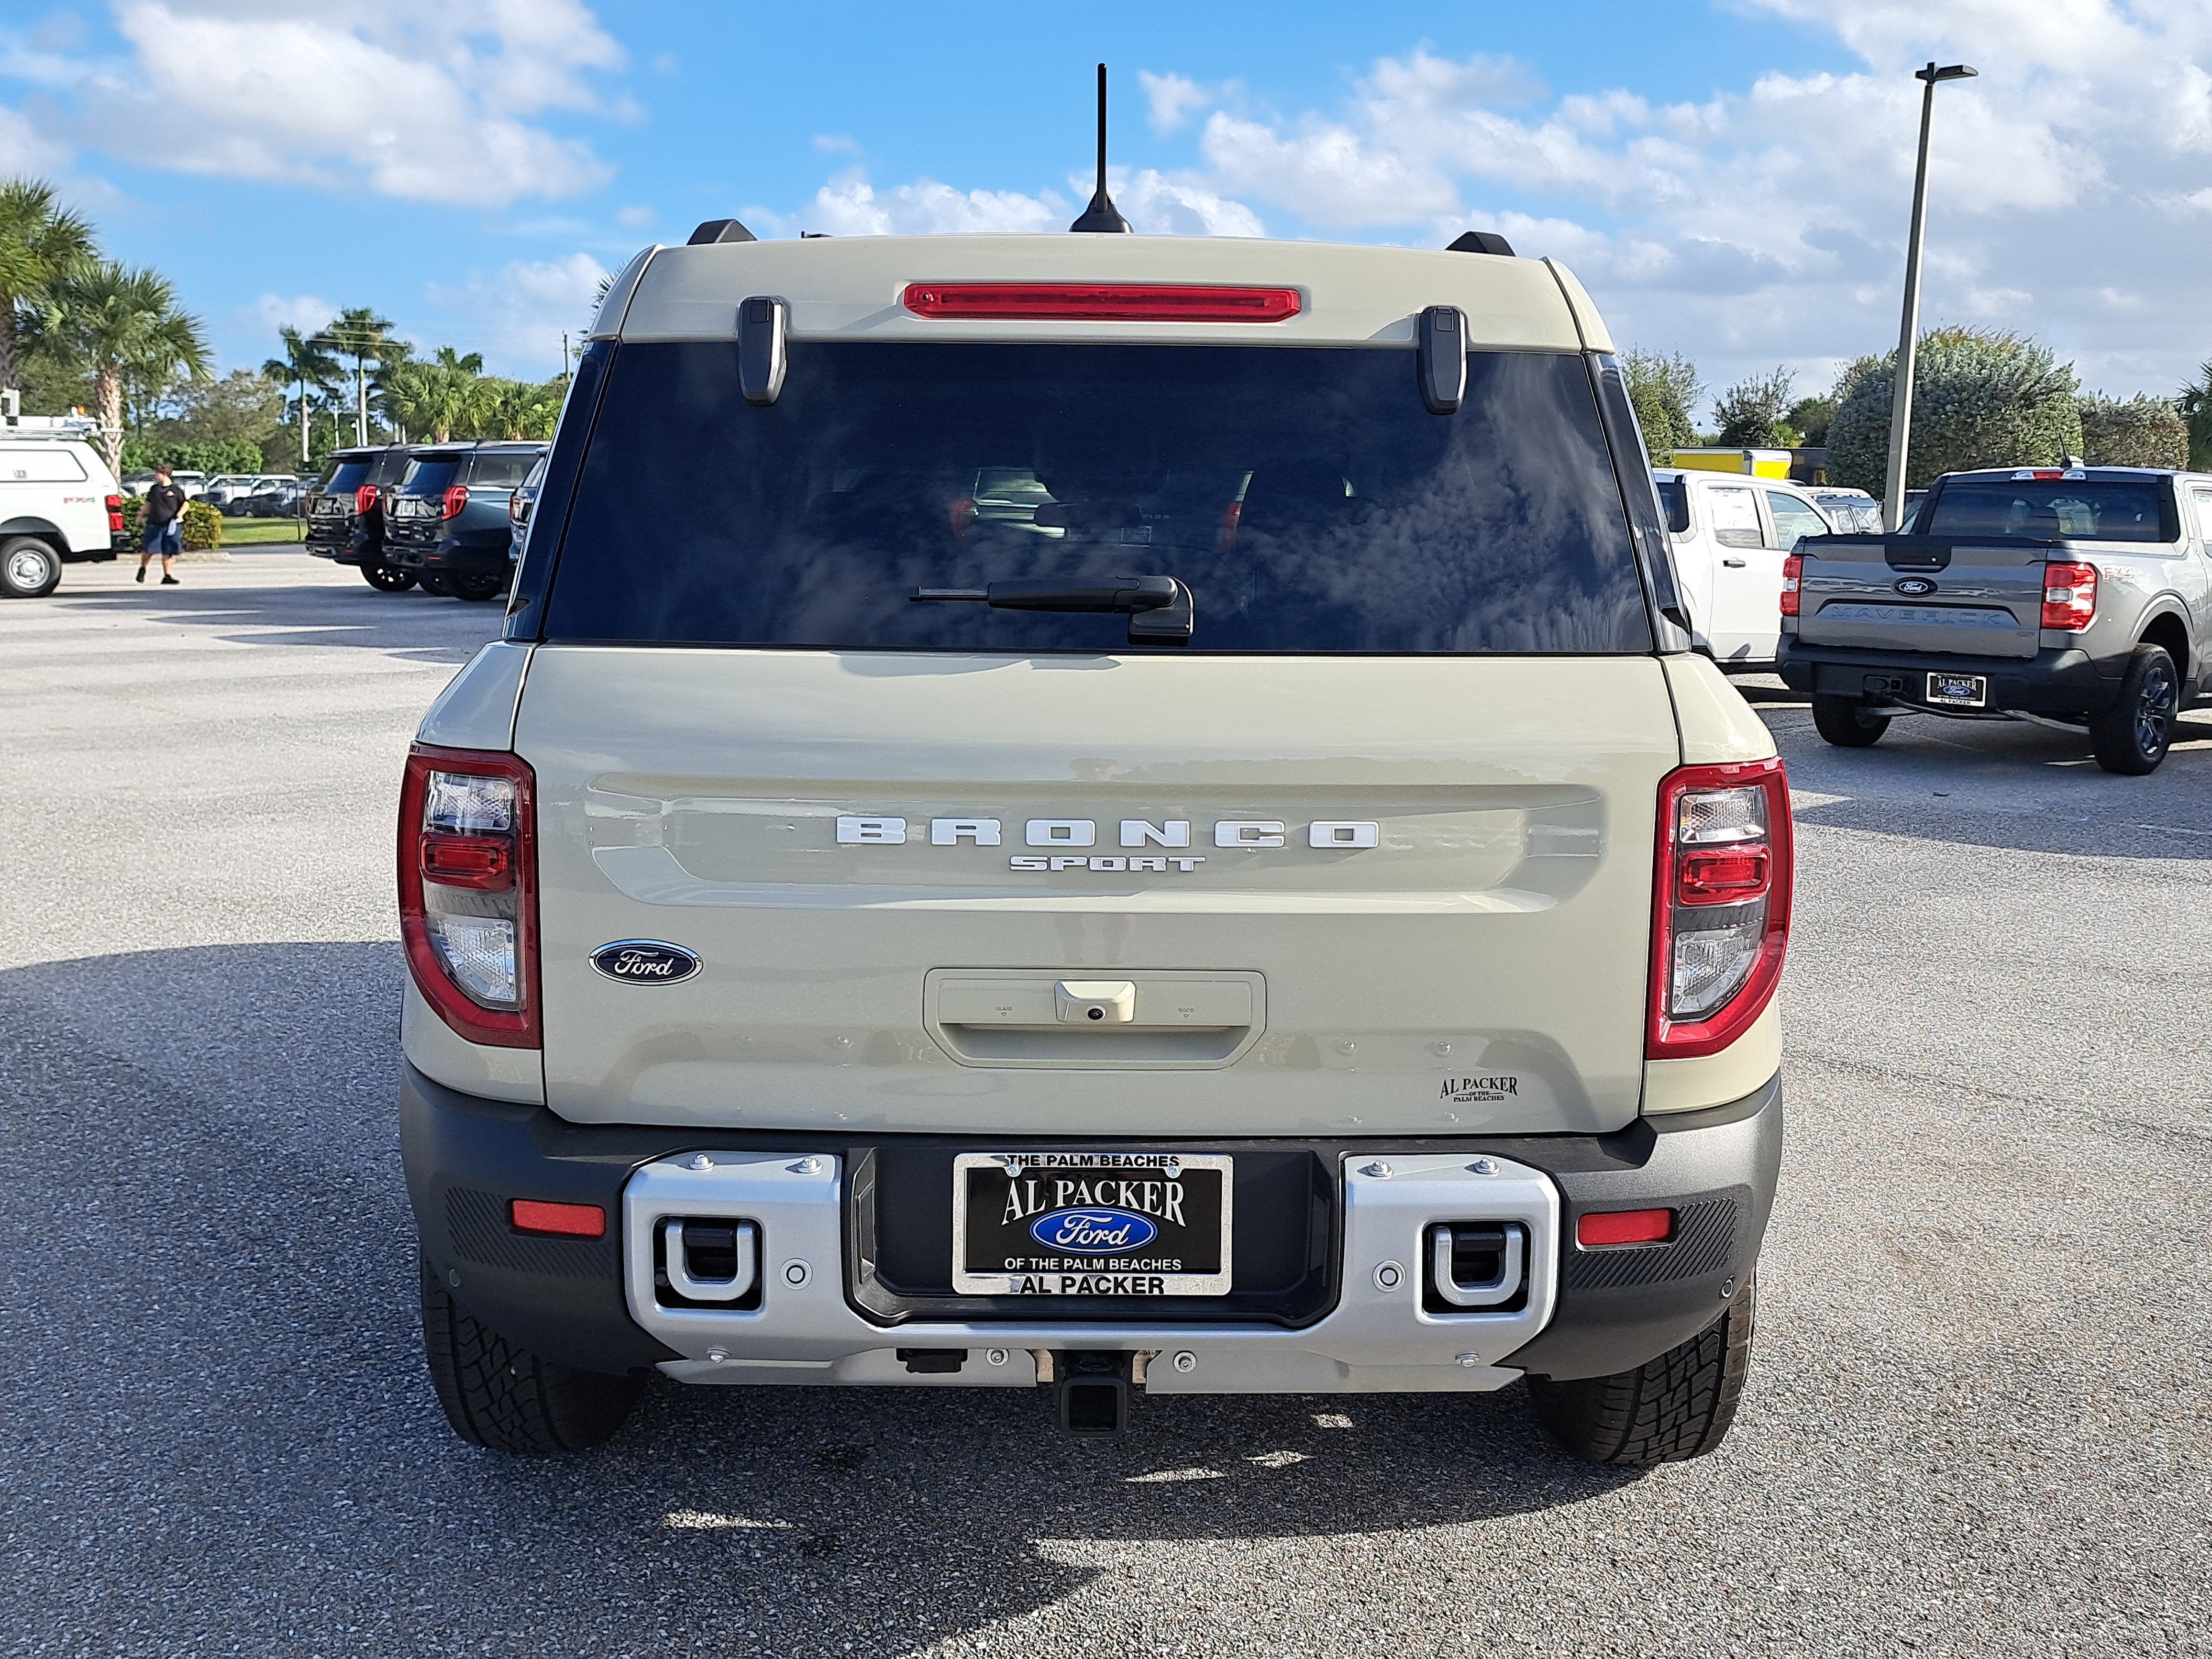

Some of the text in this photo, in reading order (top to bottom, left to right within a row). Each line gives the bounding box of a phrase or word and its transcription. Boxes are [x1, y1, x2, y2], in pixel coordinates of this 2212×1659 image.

[1904, 582, 1923, 591] Ford
[1832, 607, 2002, 624] MAVERICK
[1936, 678, 1977, 692] AL PACKER
[836, 816, 1381, 848] BRONCO
[1009, 855, 1206, 872] SPORT
[614, 950, 674, 975] Ford
[1439, 1076, 1518, 1099] AL PACKER
[1007, 1155, 1180, 1167] THE PALM BEACHES
[1001, 1179, 1186, 1228] AL PACKER
[1056, 1214, 1131, 1245] Ford
[1005, 1258, 1182, 1271] OF THE PALM BEACHES
[1019, 1276, 1165, 1295] AL PACKER
